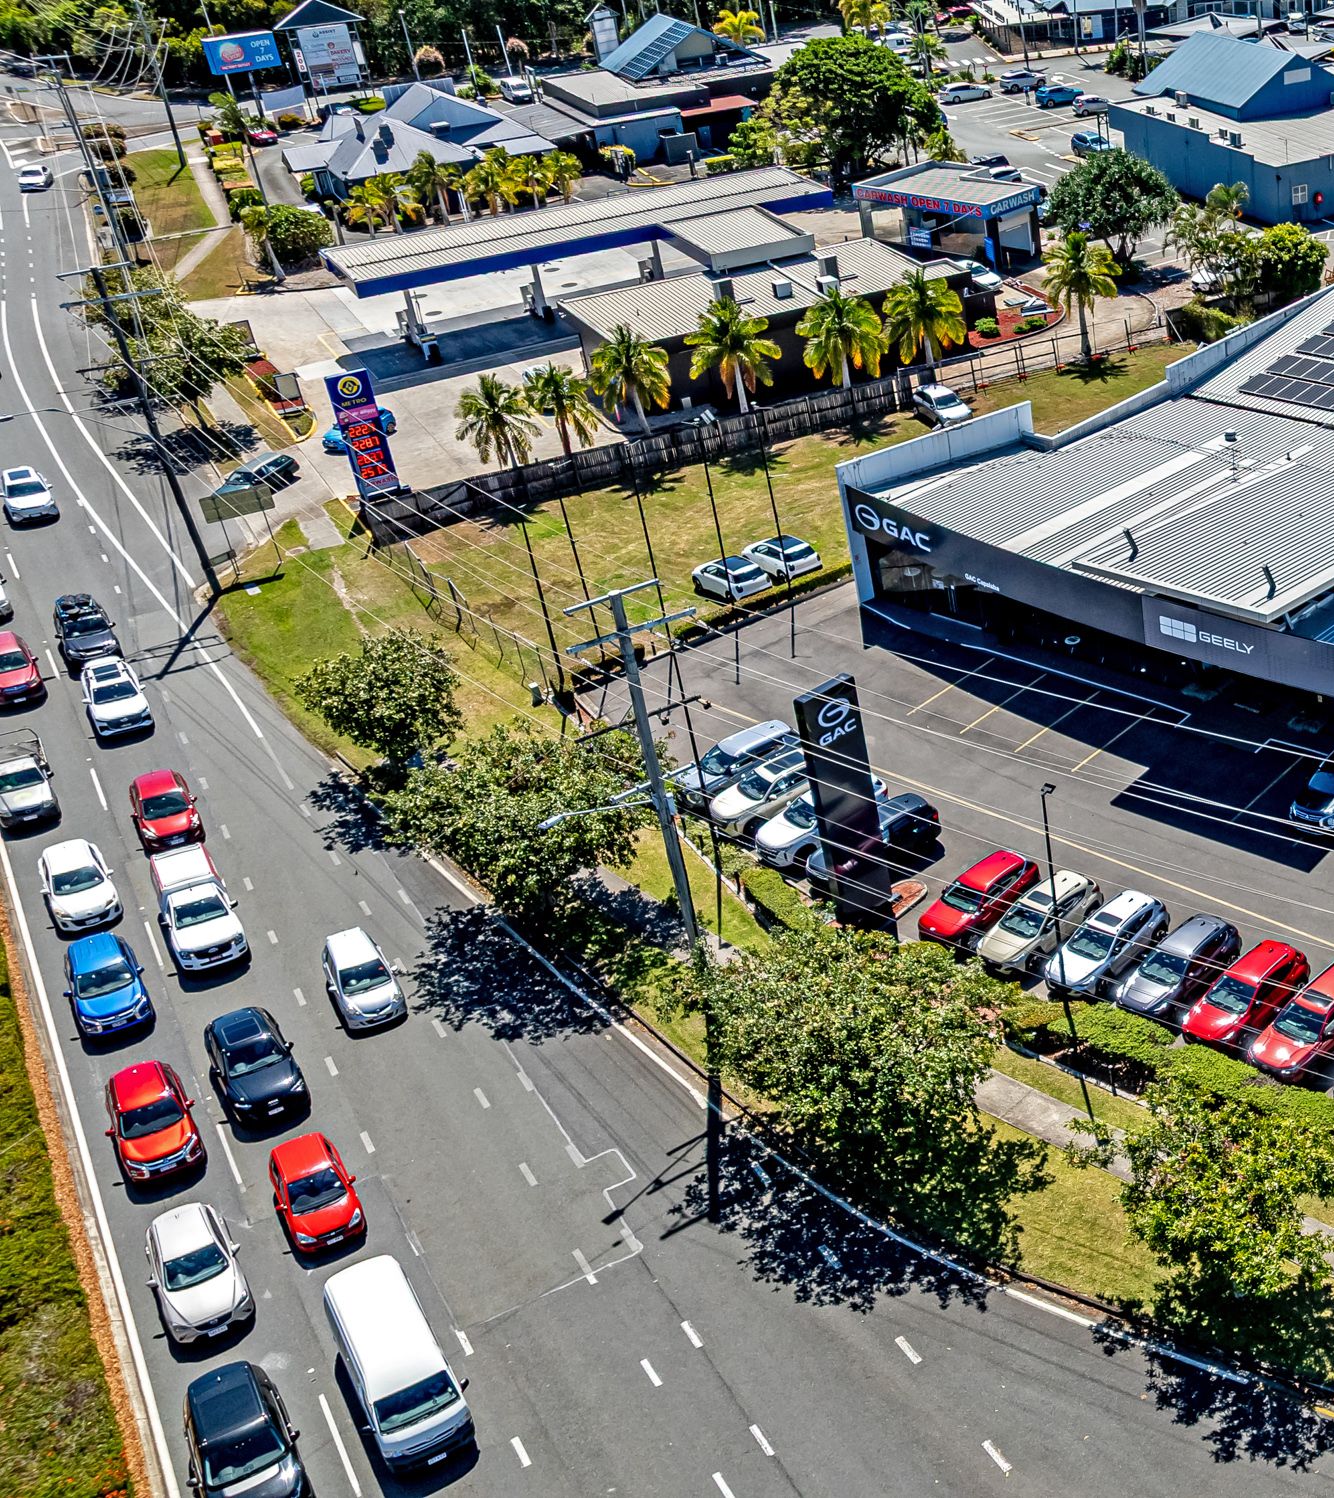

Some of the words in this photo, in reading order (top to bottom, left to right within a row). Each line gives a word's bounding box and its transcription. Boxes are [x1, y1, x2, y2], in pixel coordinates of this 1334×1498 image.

[250, 39, 271, 48] OPEN
[255, 53, 274, 63] DAYS
[855, 188, 908, 206] CARWASH
[911, 196, 941, 210] OPEN
[944, 202, 950, 211] 7
[953, 203, 983, 218] DAYS
[990, 191, 1035, 215] CARWASH
[341, 397, 367, 407] METRO
[882, 518, 931, 553] GAC
[964, 573, 977, 583] GAC
[1199, 631, 1254, 655] GEELY
[819, 718, 857, 746] GAC
